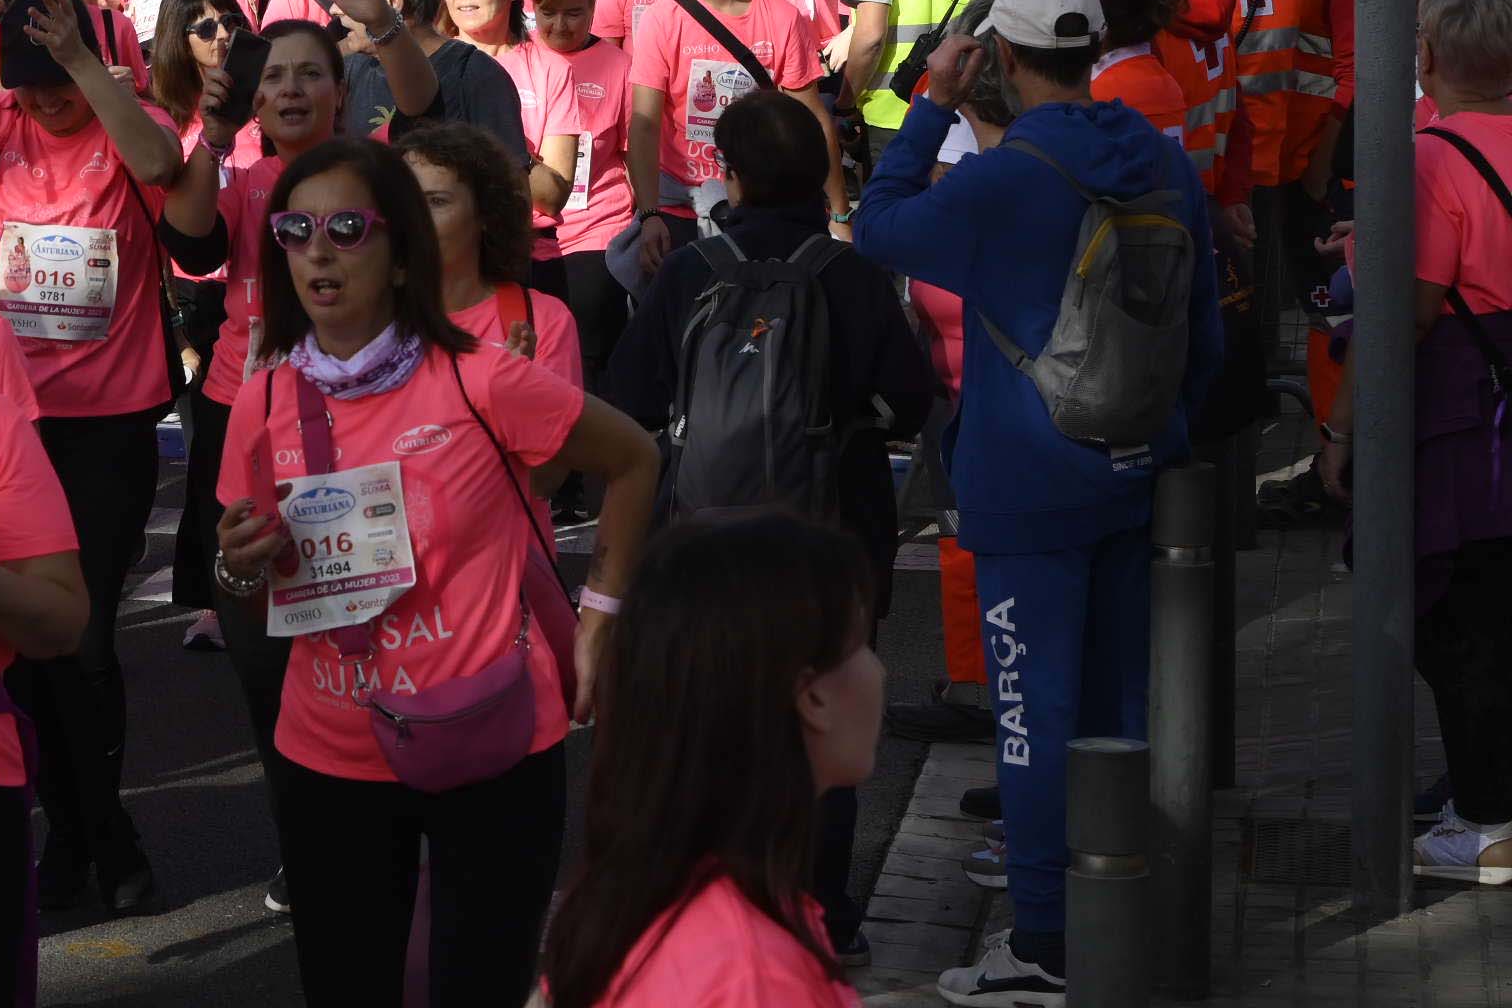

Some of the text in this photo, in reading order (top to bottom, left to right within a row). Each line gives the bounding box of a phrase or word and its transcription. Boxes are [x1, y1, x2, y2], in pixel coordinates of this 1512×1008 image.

[682, 44, 720, 55] OYSHO
[35, 242, 80, 258] ASTURIANA
[34, 270, 76, 288] 016
[39, 290, 66, 302] 9781
[38, 305, 49, 313] DE
[61, 307, 86, 315] MUJER
[8, 316, 37, 329] YSHO
[291, 497, 351, 518] ASTURIANA
[300, 531, 355, 561] 016
[311, 561, 352, 580] 31494
[316, 584, 329, 596] DE
[330, 582, 343, 592] LA
[344, 577, 377, 590] MUJER
[284, 607, 323, 626] OYSHO
[985, 596, 1031, 767] BARÇA
